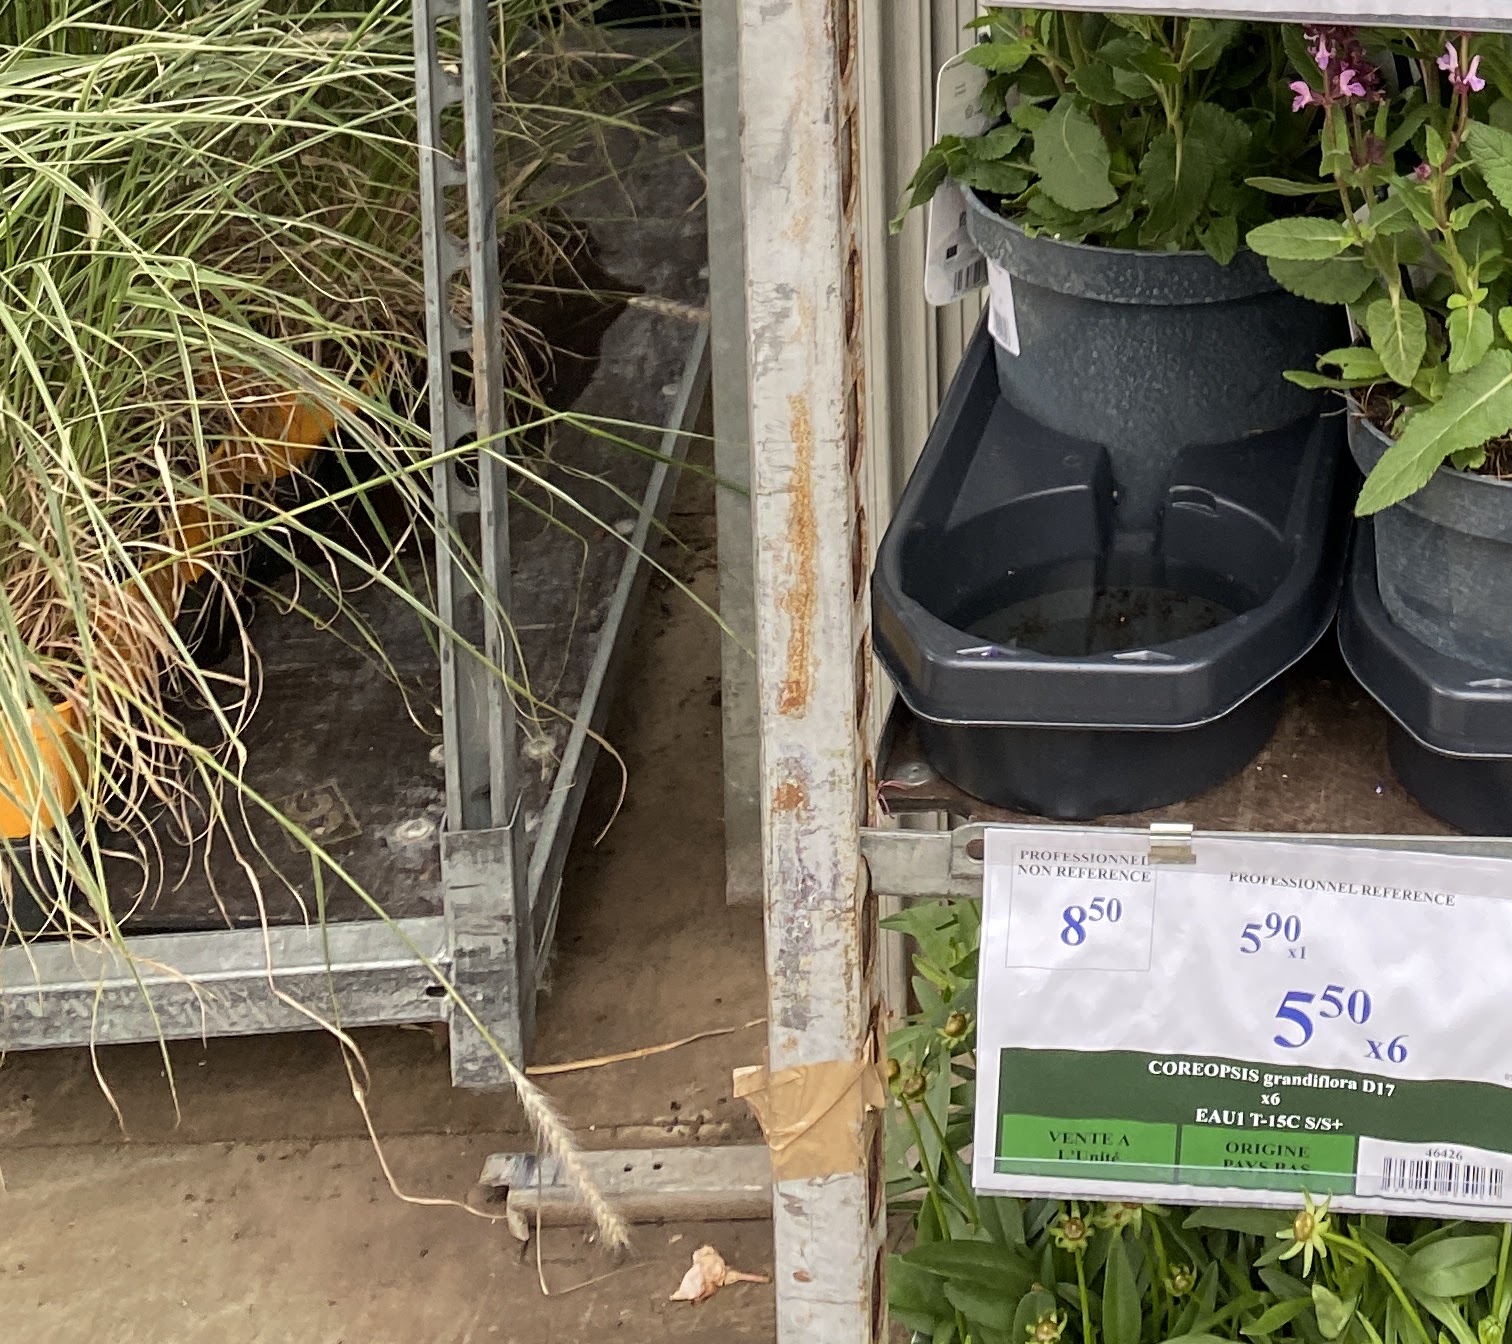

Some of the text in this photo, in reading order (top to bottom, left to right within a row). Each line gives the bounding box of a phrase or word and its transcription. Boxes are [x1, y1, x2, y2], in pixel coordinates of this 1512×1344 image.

[1018, 865, 1151, 882] NON REFERENCE
[1230, 872, 1456, 906] PROFESSIONNEL REFERENCE
[1288, 946, 1307, 959] x1
[1365, 1034, 1409, 1064] x6
[1149, 1061, 1395, 1097] COREOPSIS grandiflora D17
[1261, 1092, 1280, 1105] x6
[1250, 1113, 1300, 1129] T-15C
[1304, 1116, 1343, 1131] S/S+
[1049, 1130, 1130, 1146] VENTE A
[1226, 1142, 1310, 1158] ORIGINE
[1425, 1147, 1463, 1160] 46426
